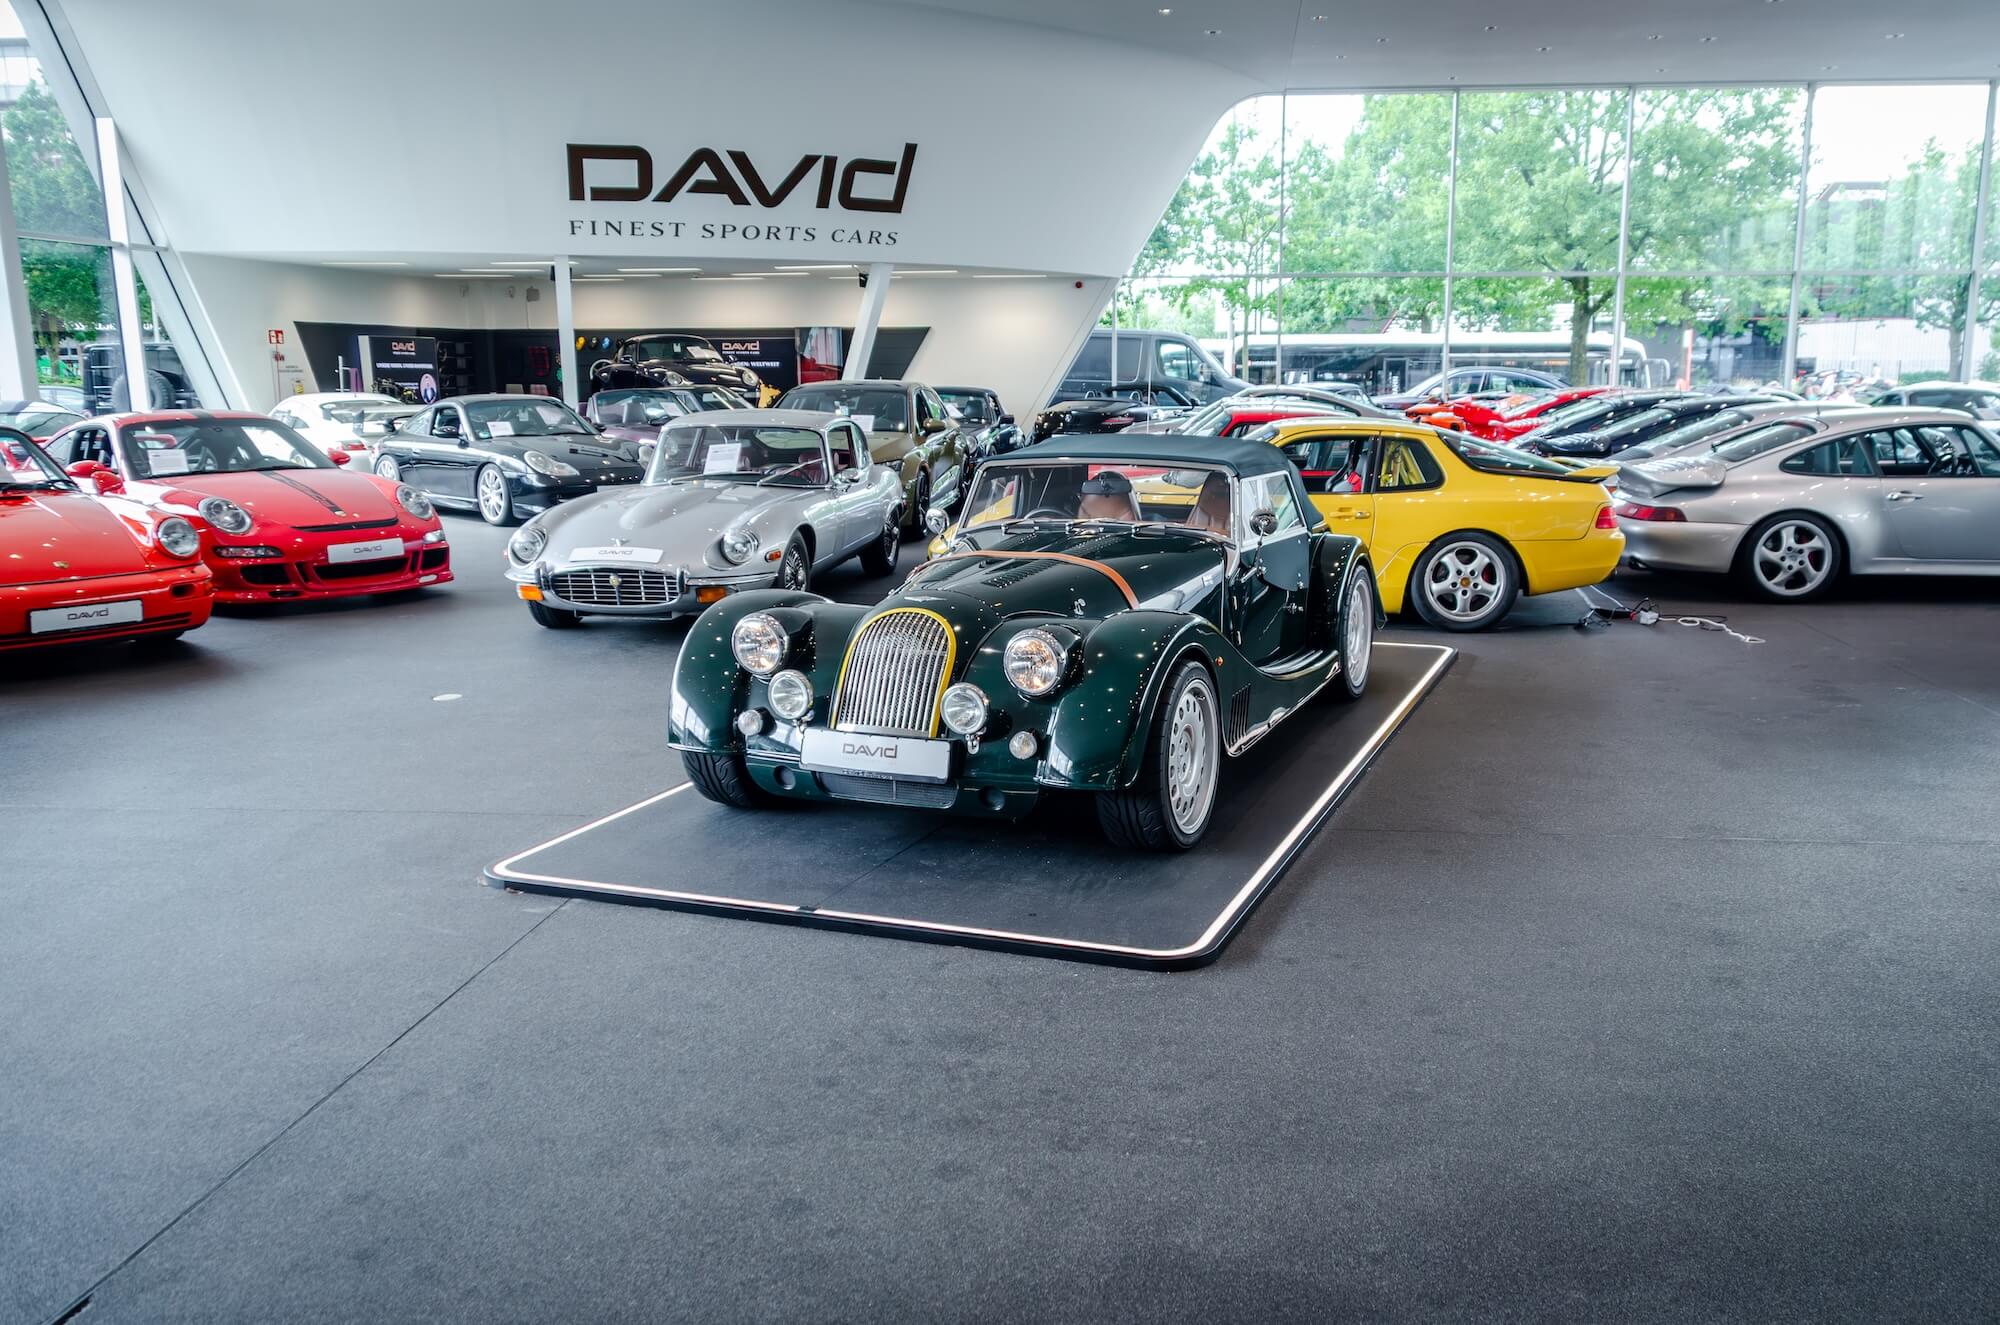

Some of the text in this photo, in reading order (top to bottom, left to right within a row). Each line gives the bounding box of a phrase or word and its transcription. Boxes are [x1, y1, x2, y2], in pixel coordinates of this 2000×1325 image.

[569, 220, 899, 246] FINEST SPORTS CARS
